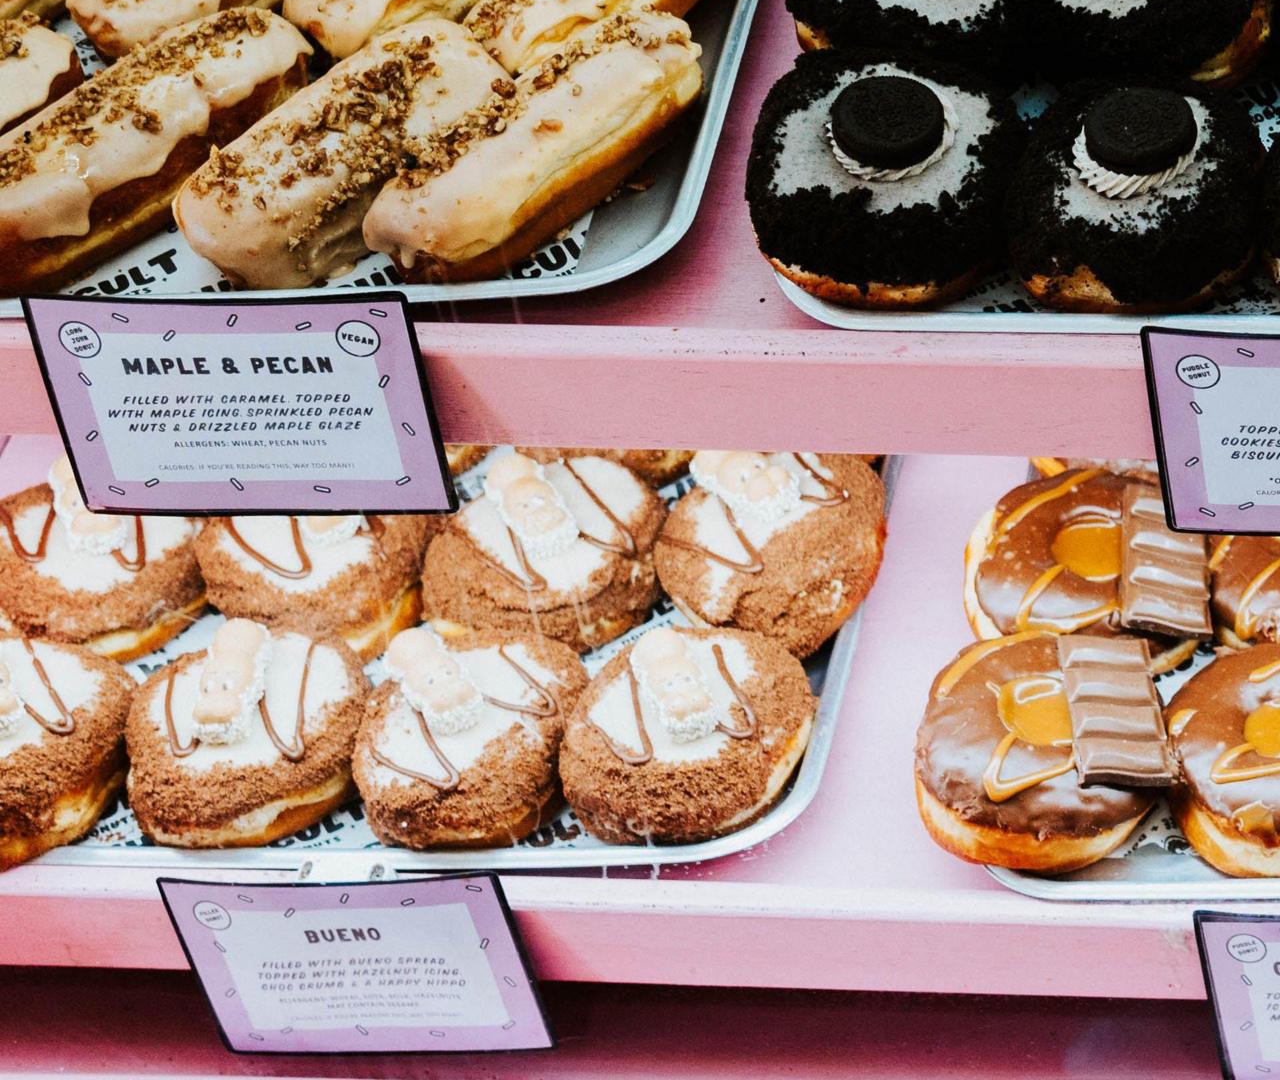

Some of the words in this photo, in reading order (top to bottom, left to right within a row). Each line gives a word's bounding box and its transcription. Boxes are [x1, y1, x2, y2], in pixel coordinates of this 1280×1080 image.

[340, 332, 375, 347] VEGAN
[121, 357, 210, 375] MAPLE
[221, 357, 240, 375] &
[250, 356, 333, 375] PECAN
[123, 395, 169, 406] FILLED
[175, 395, 214, 405] WITH
[296, 393, 351, 403] TOPPED
[108, 409, 144, 419] WITH
[150, 408, 196, 418] MAPLE
[247, 407, 323, 417] SPRINKLED
[328, 407, 374, 417] PECAN
[128, 422, 167, 433] NUTS
[172, 423, 181, 432] &
[188, 421, 257, 433] DRIZZLED
[264, 421, 312, 431] MAPLE
[318, 420, 362, 431] GLAZE
[304, 927, 381, 944] BUENO
